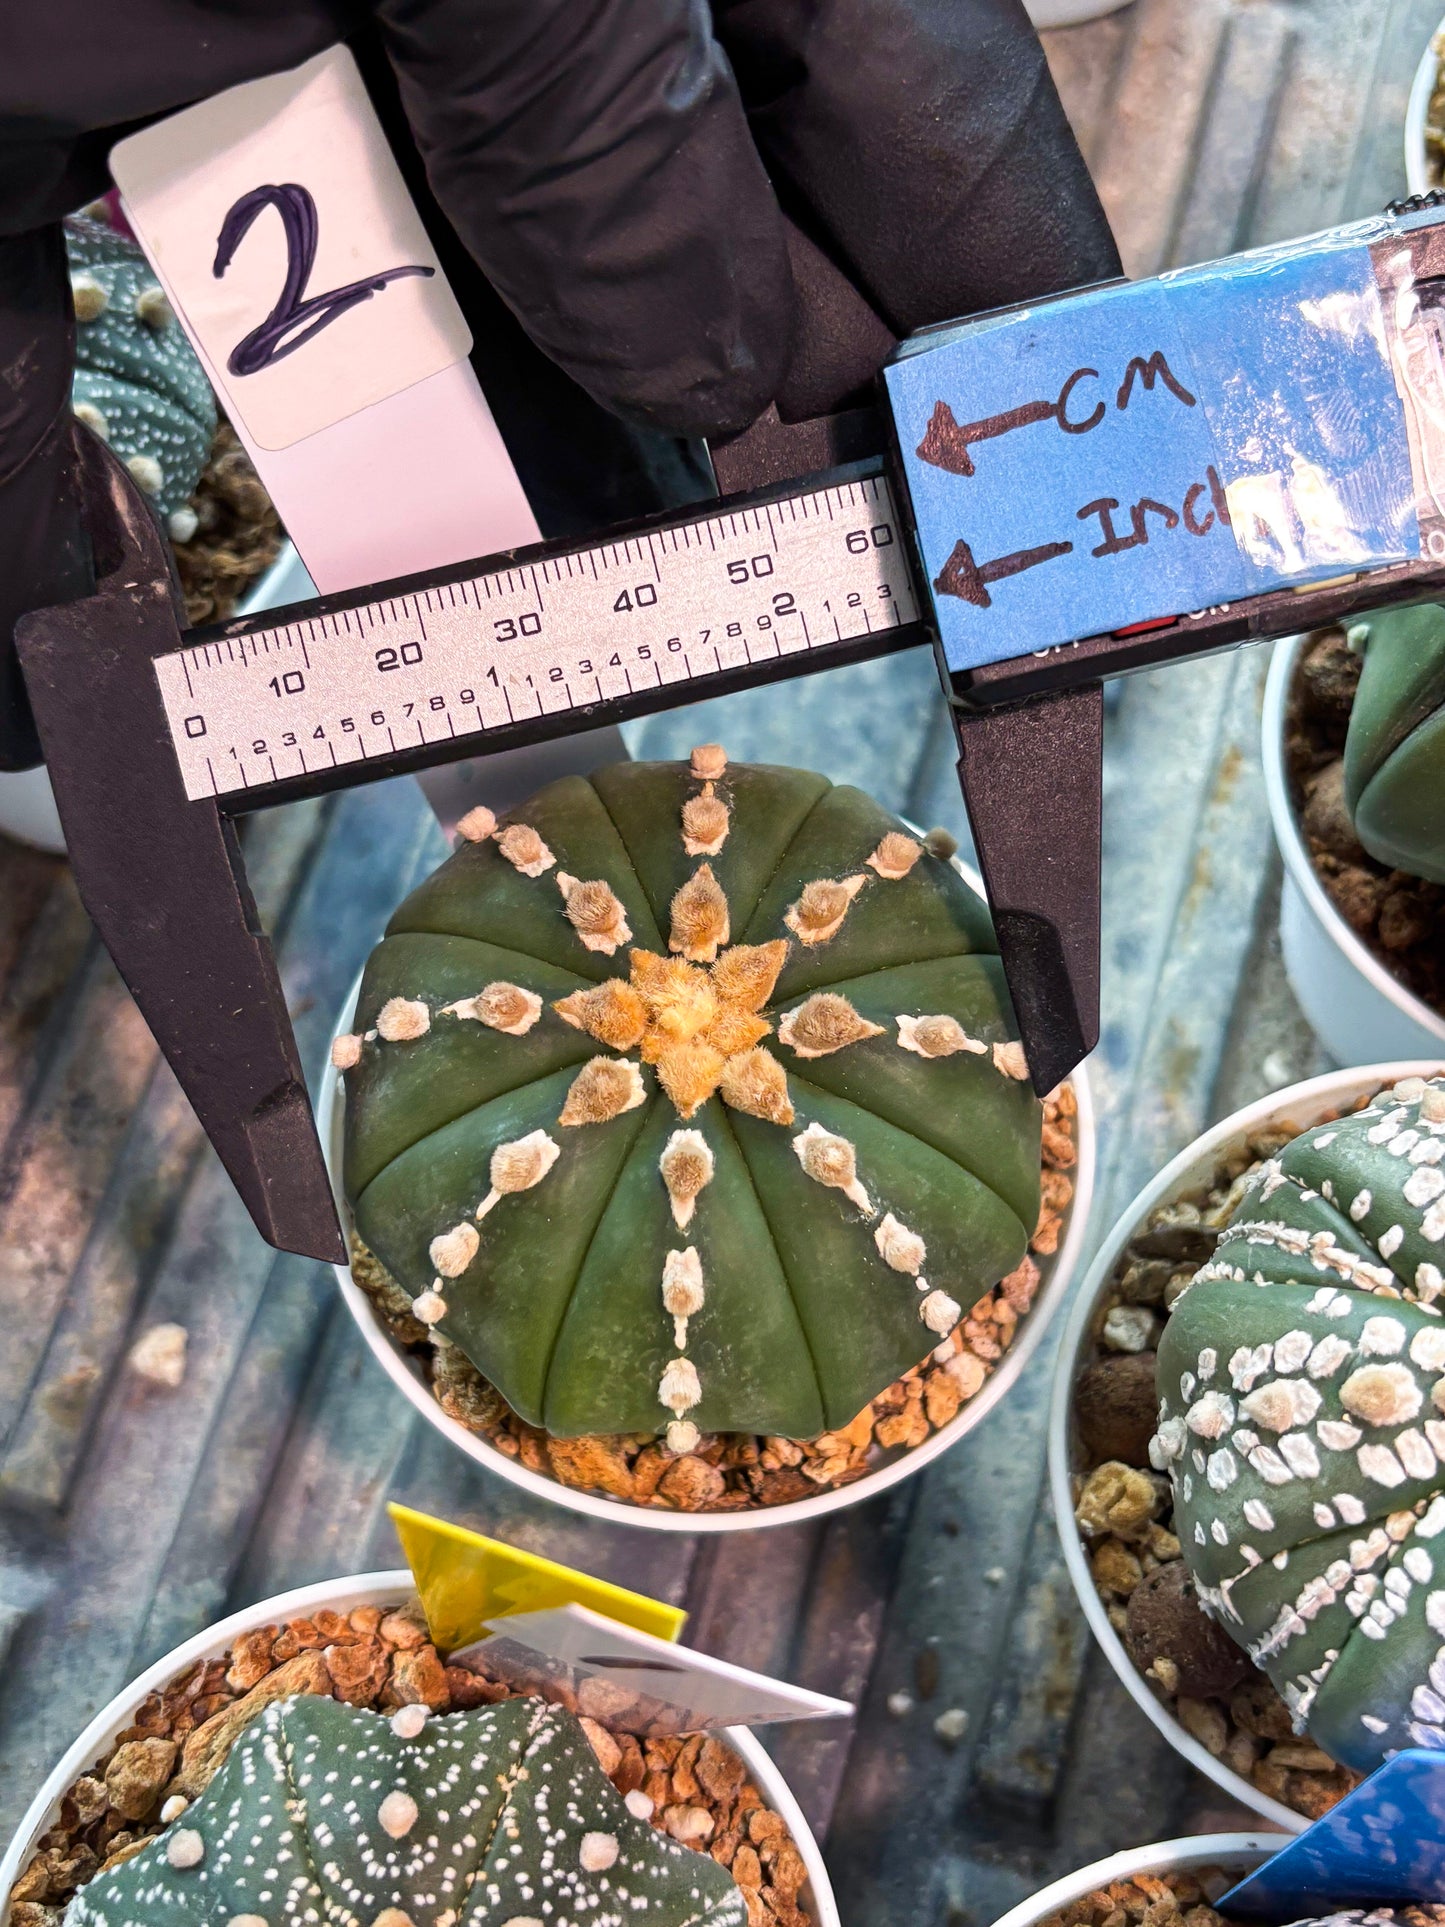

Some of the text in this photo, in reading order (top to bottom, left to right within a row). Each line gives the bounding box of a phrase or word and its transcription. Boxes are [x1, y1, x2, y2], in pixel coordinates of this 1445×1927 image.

[213, 183, 436, 377] 2
[184, 584, 892, 759] 0 1 2 3 4 5 6 7 8 9 1 1 2 3 4 5 6 7 8 9 2 1 2 3
[269, 523, 894, 697] 10 20 30 40 50 60
